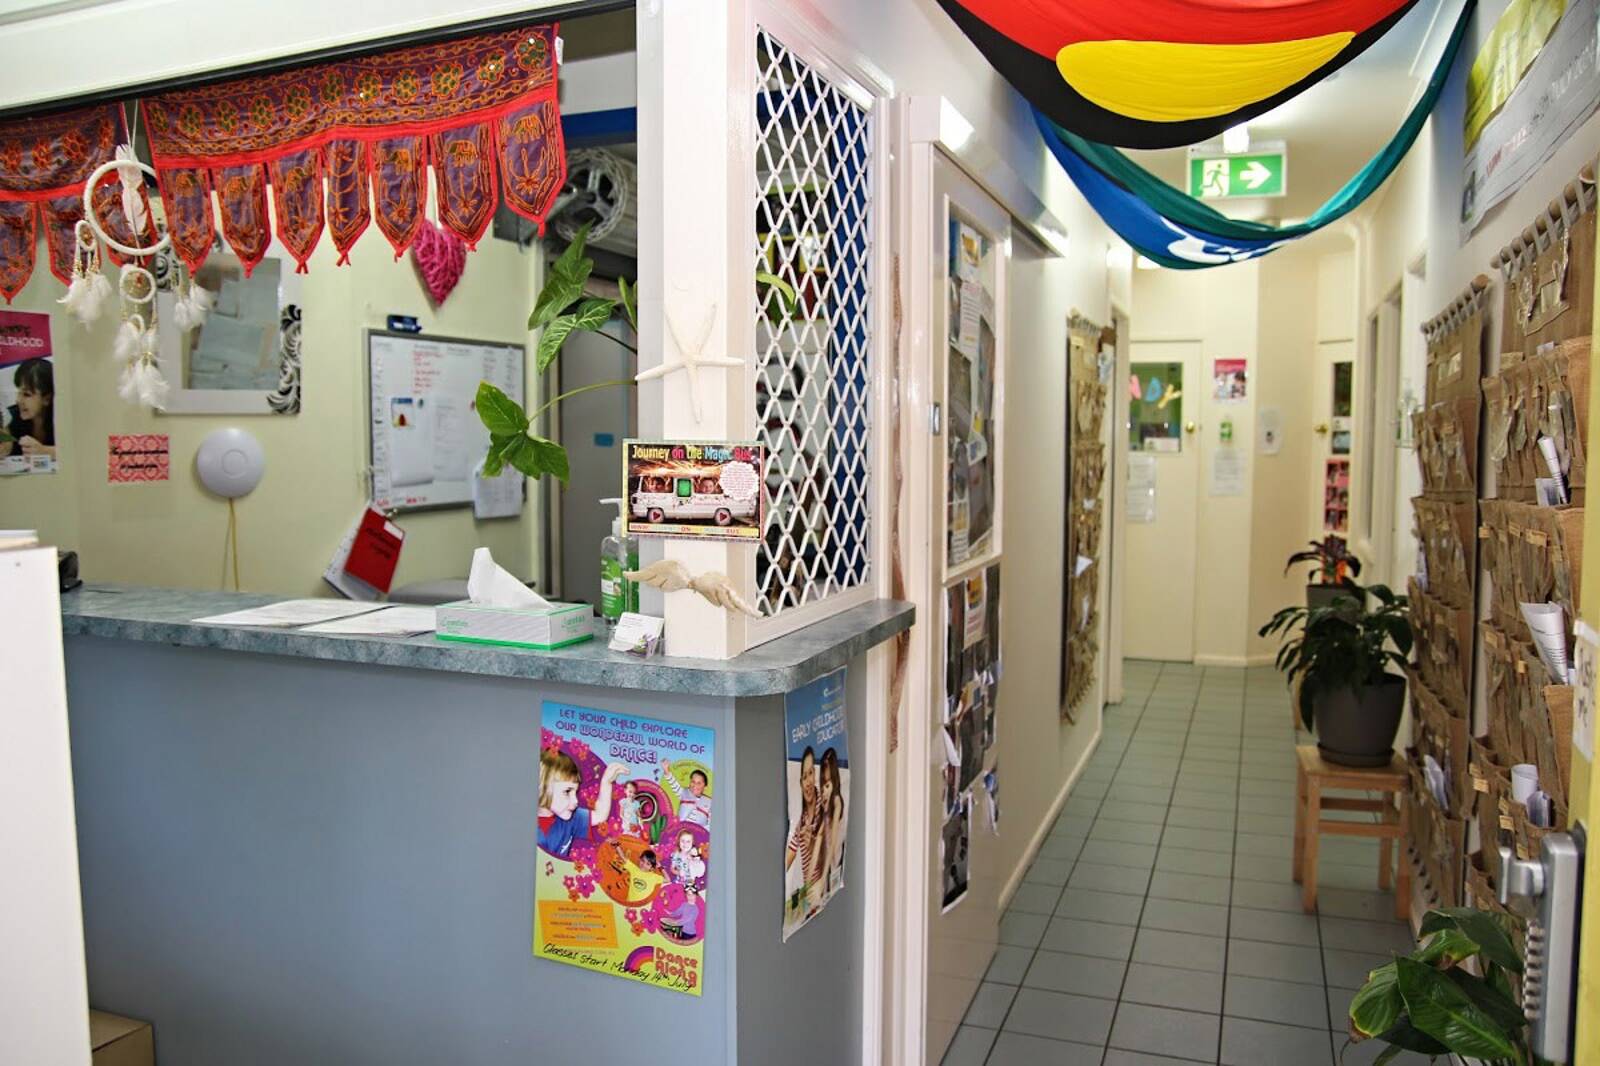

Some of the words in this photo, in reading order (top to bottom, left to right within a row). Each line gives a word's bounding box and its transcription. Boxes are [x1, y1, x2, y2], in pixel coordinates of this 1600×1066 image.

[632, 445, 671, 460] Journey
[672, 447, 684, 460] on
[559, 708, 576, 719] LET
[578, 712, 607, 724] YOUR
[610, 717, 638, 731] CHILD
[641, 722, 688, 737] EXPLORE
[792, 720, 811, 743] EARLY
[555, 721, 577, 732] OUR
[579, 725, 646, 746] WONDERFUL
[648, 737, 687, 751] WORLD
[689, 745, 705, 755] OF
[610, 745, 657, 764] DANCE!
[543, 943, 580, 960] Classes
[581, 954, 608, 967] Start
[670, 975, 692, 992] July
[656, 947, 698, 969] Dance
[656, 961, 698, 988] Along
